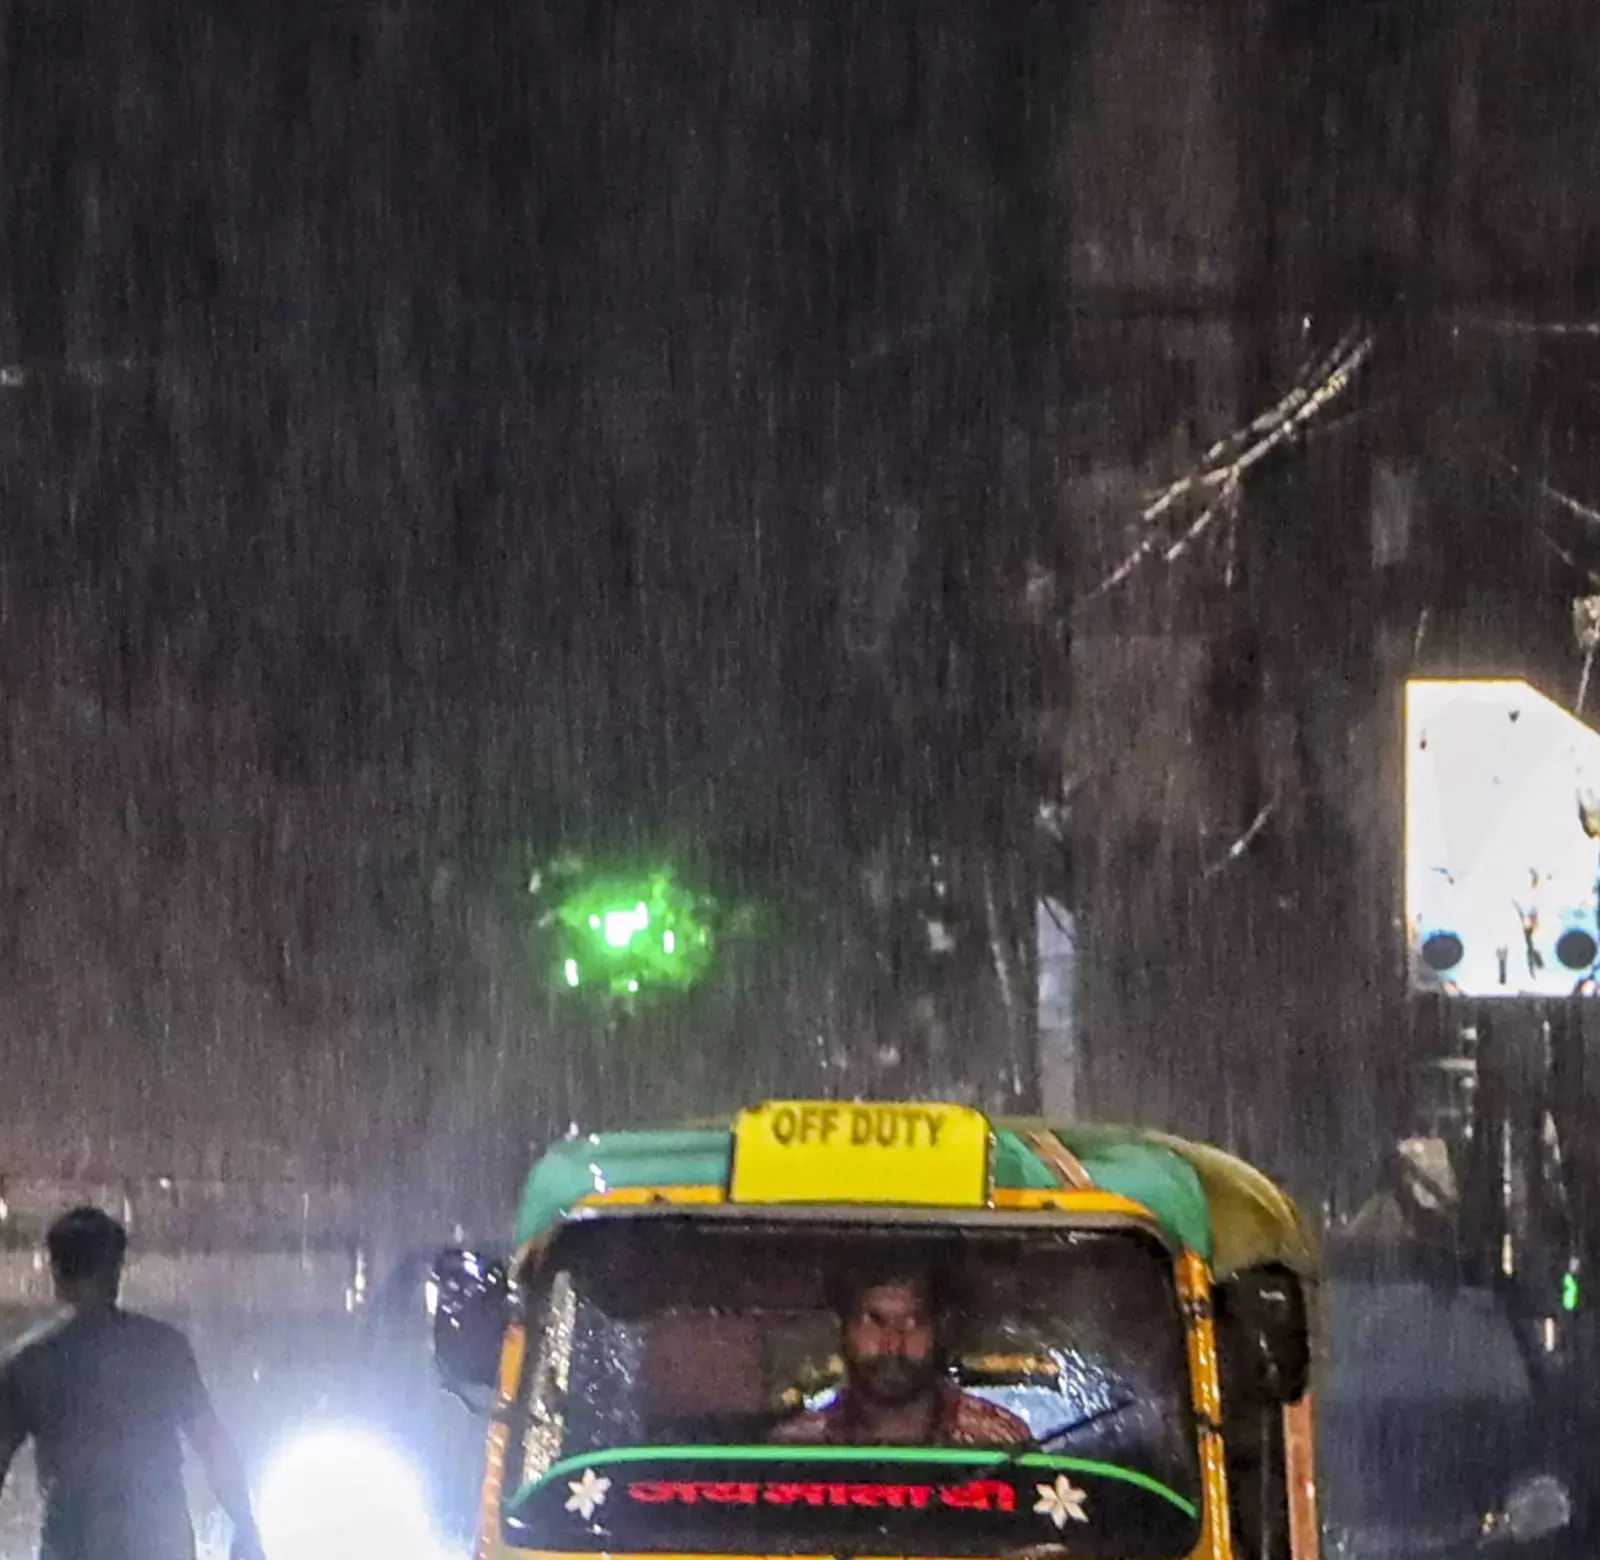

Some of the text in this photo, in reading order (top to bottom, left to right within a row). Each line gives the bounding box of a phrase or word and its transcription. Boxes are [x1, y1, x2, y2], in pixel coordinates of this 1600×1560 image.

[770, 1107, 946, 1148] OFF DUTY
[627, 1480, 758, 1504] जय
[762, 1482, 934, 1508] माता
